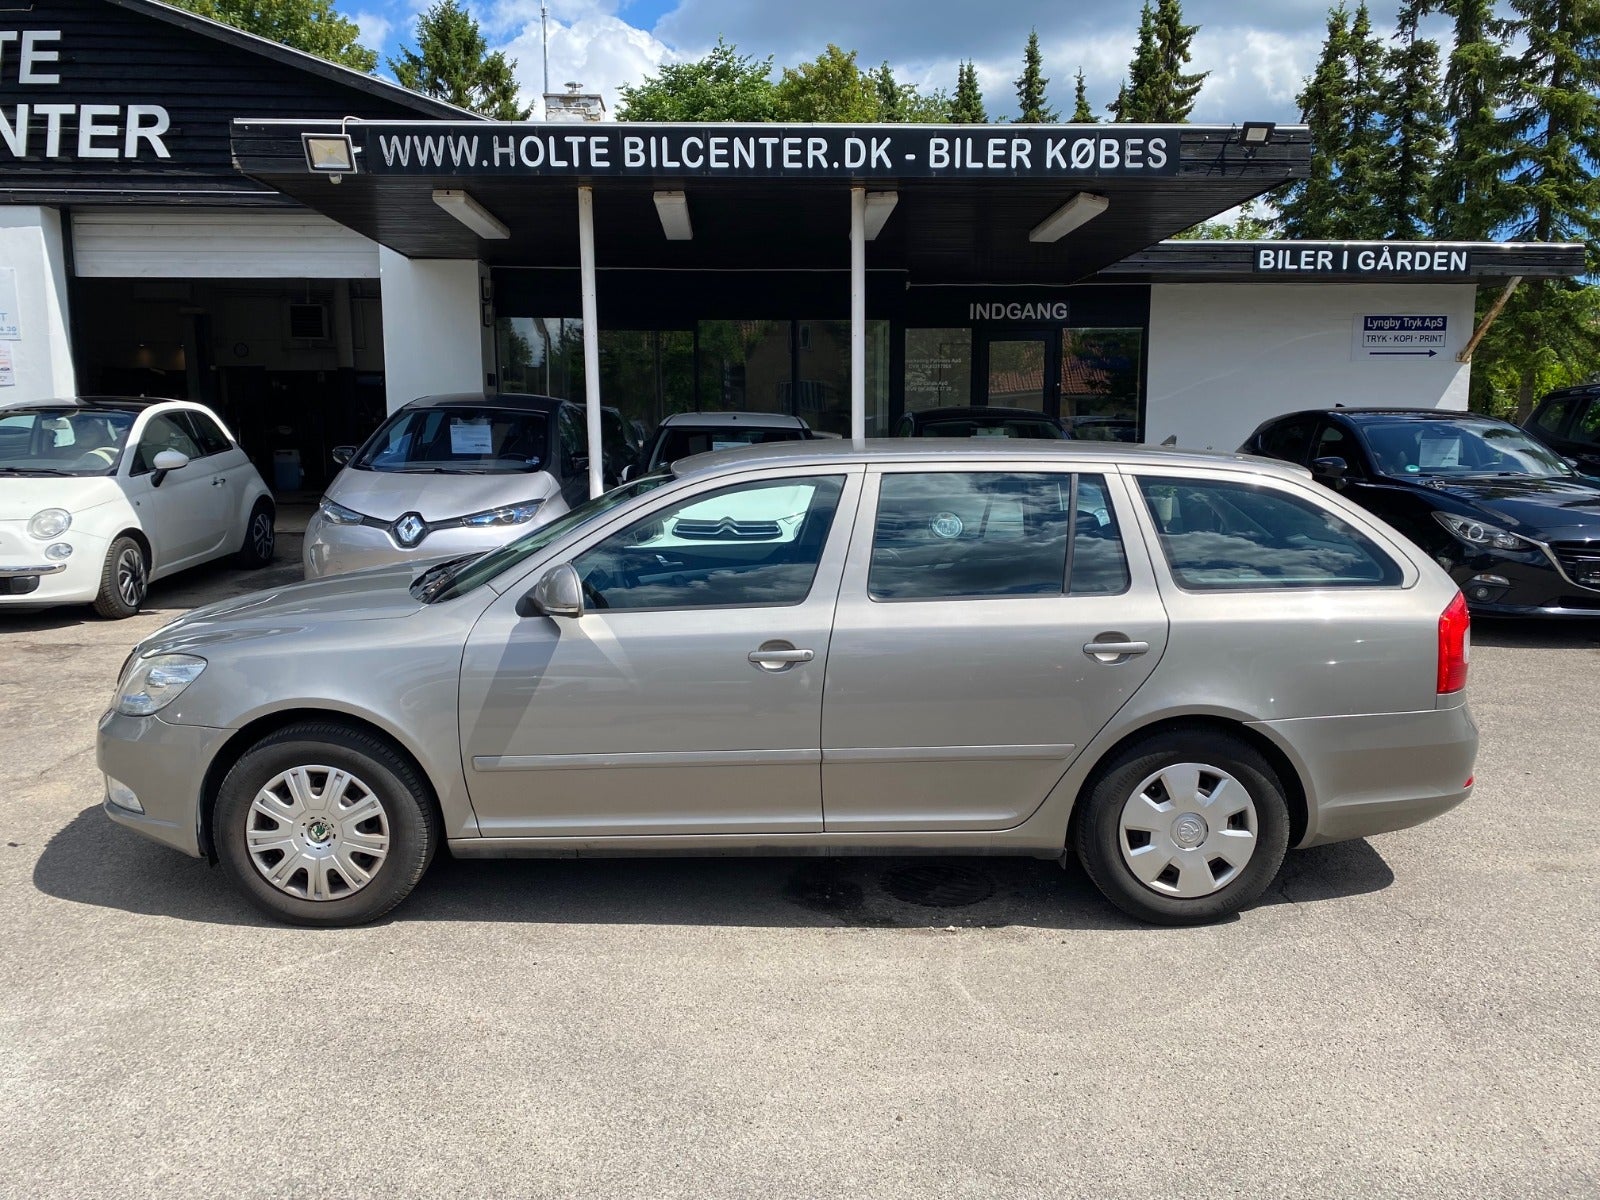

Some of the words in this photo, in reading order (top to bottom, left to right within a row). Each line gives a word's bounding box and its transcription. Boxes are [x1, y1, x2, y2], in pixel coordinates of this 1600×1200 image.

[379, 135, 610, 168] WWW.HOLTE
[624, 136, 892, 169] BILCENTER.DK
[929, 137, 1032, 169] BILER
[1046, 137, 1168, 169] KØBES
[1259, 250, 1333, 270] BILER
[1342, 250, 1349, 270] I
[1357, 246, 1467, 271] GÅRDEN
[969, 303, 1068, 320] INDGANG
[1367, 317, 1401, 329] Lyngby
[1403, 317, 1422, 329] Tryk
[1424, 318, 1444, 329] ApS
[1366, 334, 1388, 342] TRYK
[1394, 334, 1413, 342] KOPI
[1420, 334, 1443, 342] PRINT
